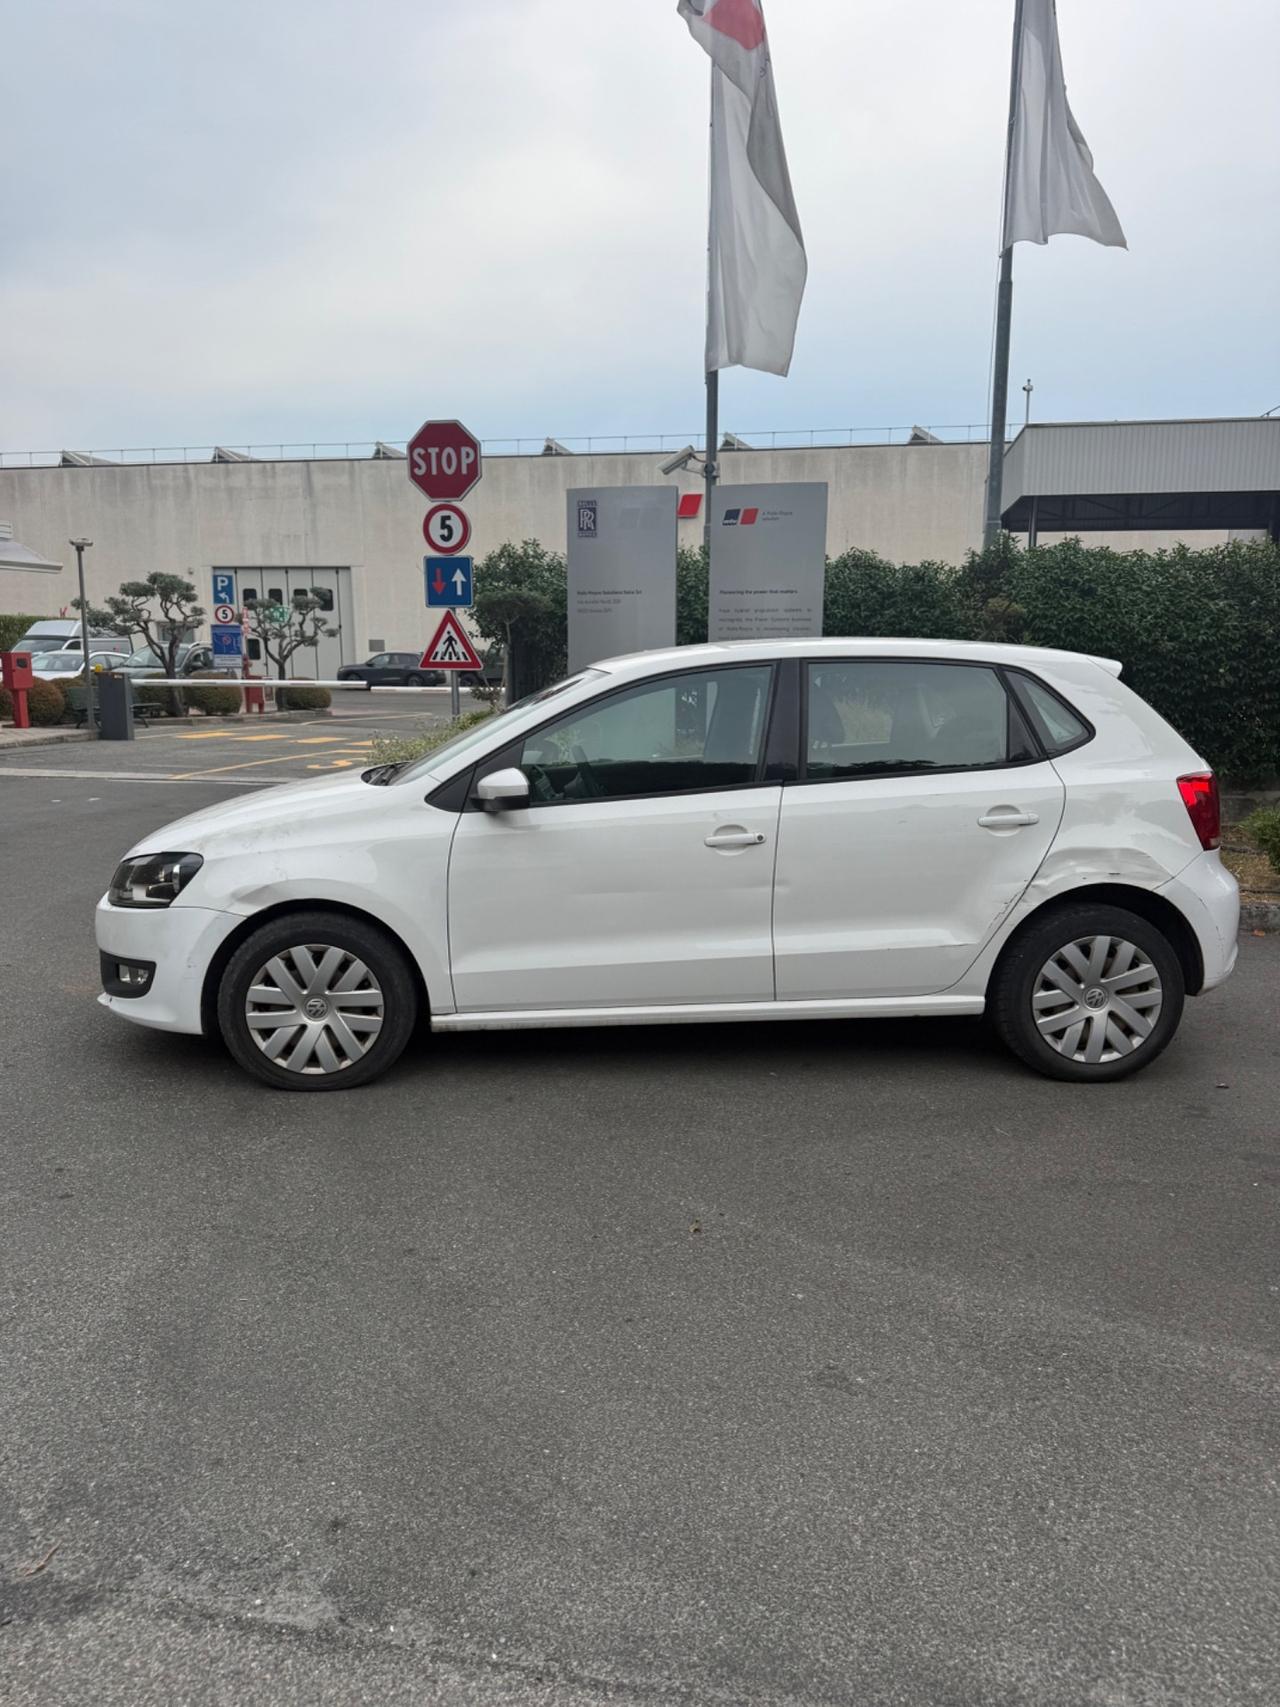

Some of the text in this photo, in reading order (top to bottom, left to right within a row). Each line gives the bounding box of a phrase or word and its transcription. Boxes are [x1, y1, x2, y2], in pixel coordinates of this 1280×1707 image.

[412, 446, 475, 475] STOP
[439, 514, 454, 542] 5
[217, 576, 229, 591] P
[221, 609, 229, 620] 5
